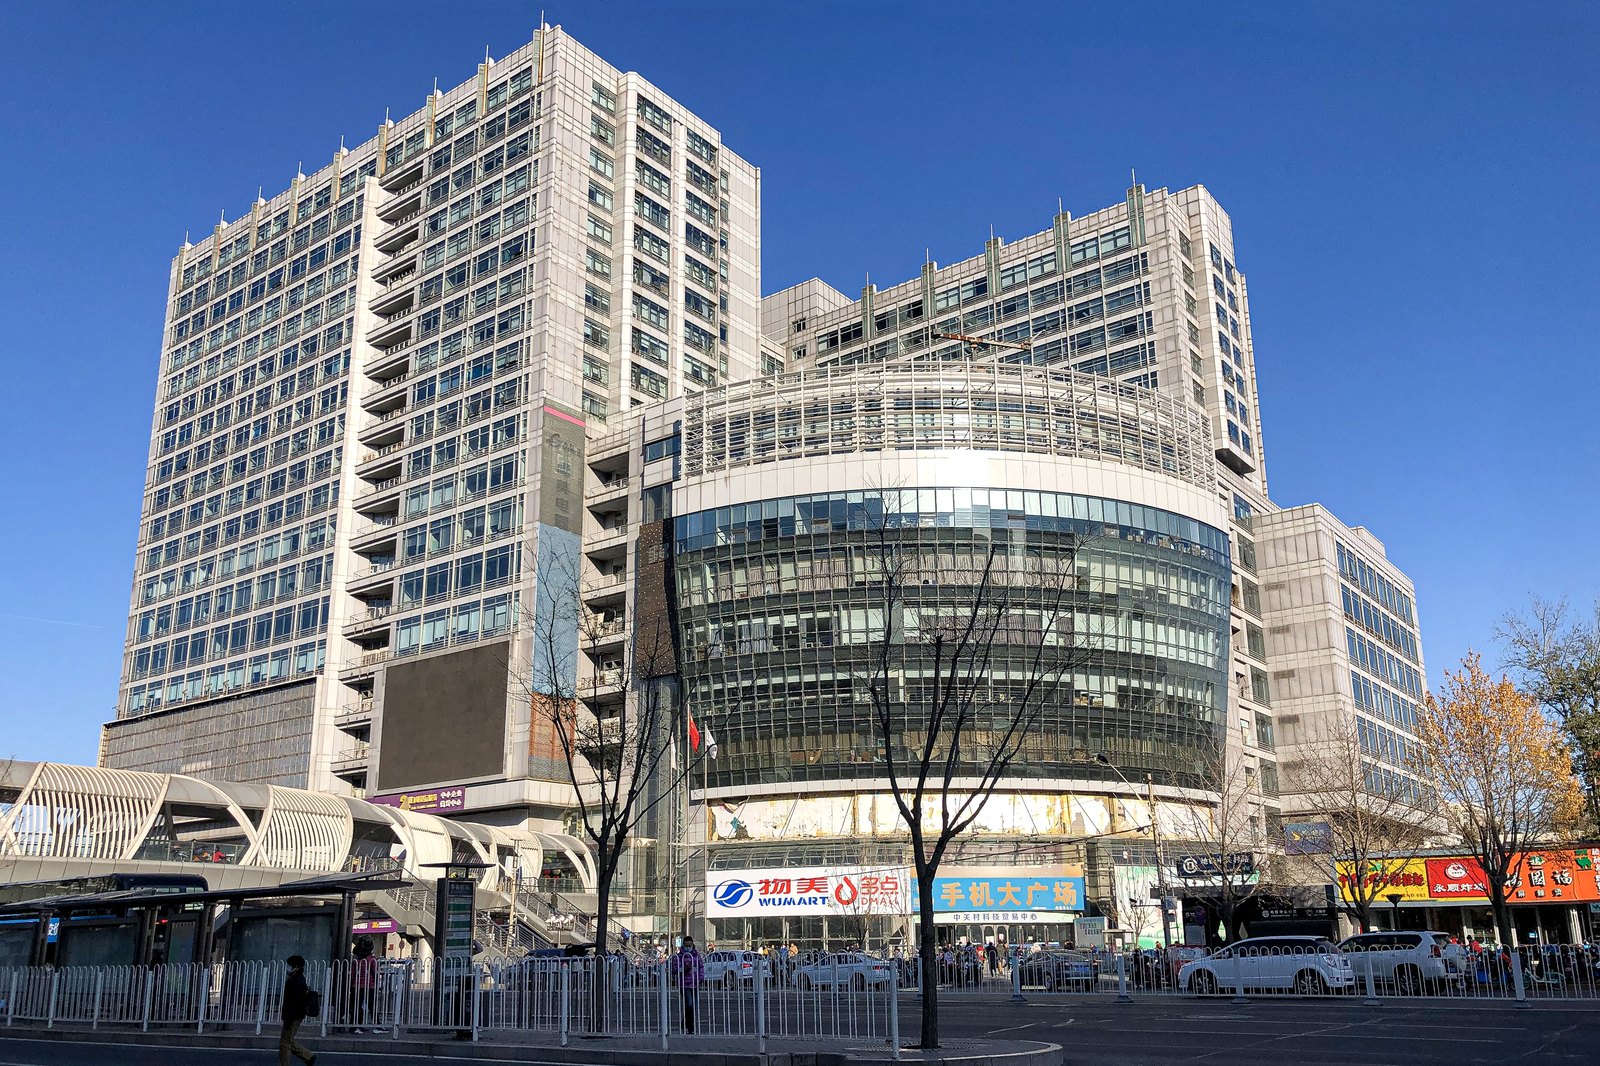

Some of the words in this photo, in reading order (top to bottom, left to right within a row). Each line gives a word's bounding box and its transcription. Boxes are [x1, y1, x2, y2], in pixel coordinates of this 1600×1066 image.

[758, 876, 828, 895] 物美
[861, 875, 899, 894] 多点
[758, 896, 828, 906] WUMART
[941, 881, 1077, 907] 手机大广场
[861, 897, 899, 906] DMALL
[953, 912, 1038, 921] 中关村科技贸易中心
